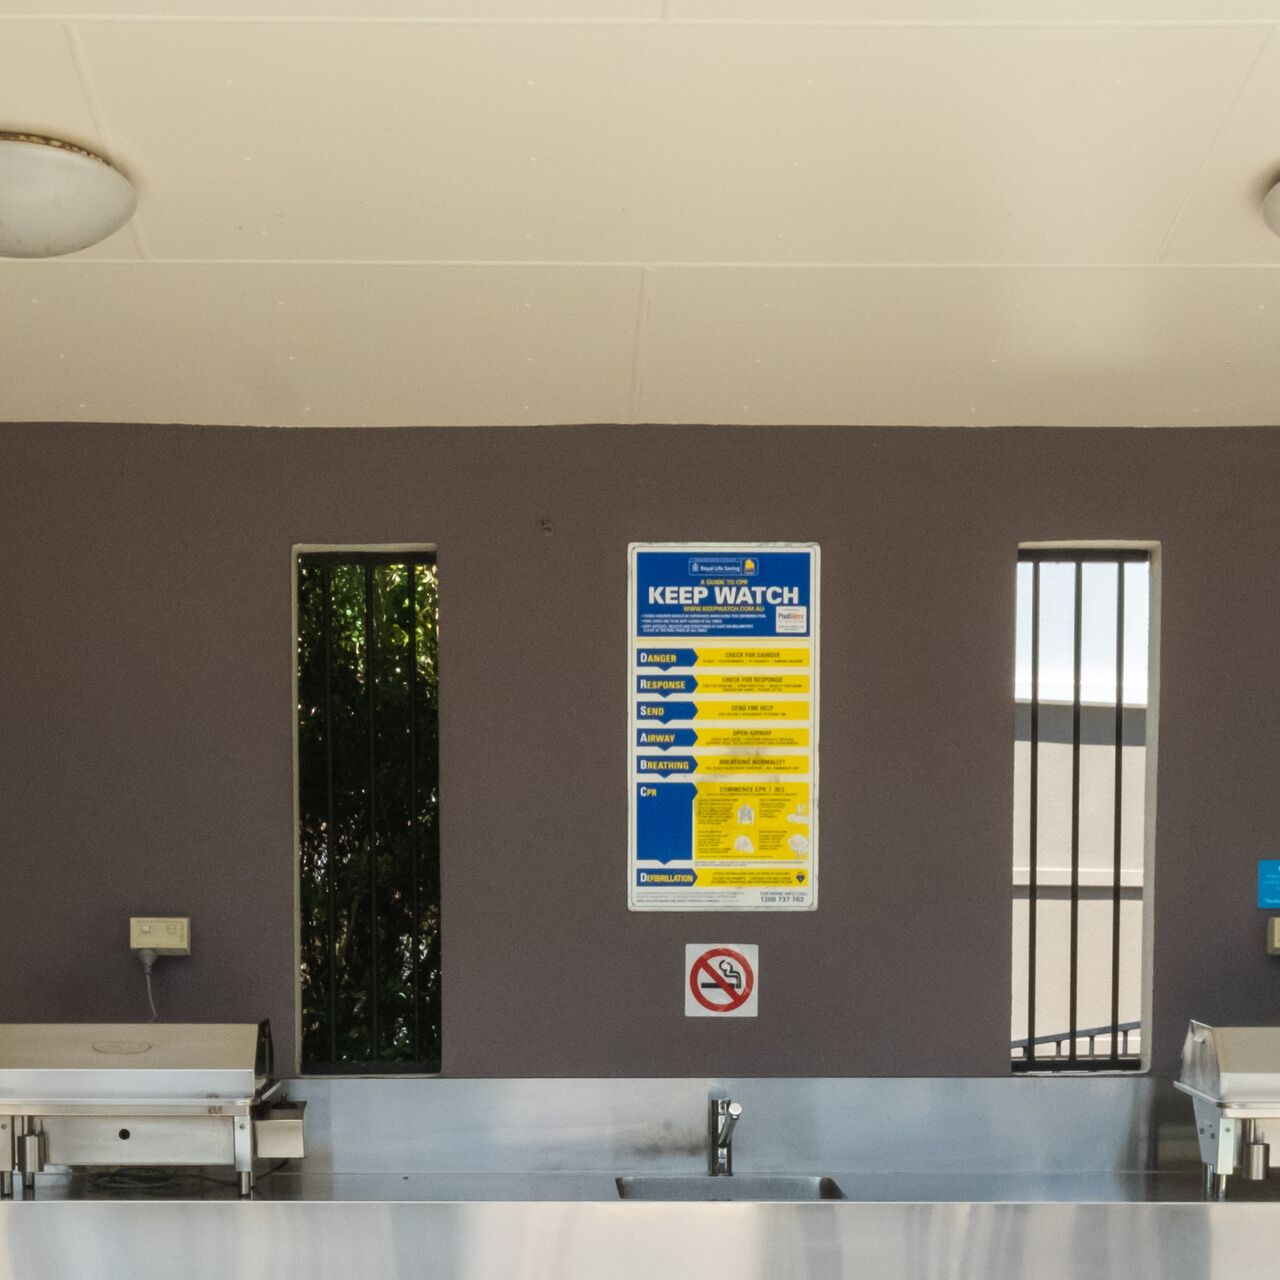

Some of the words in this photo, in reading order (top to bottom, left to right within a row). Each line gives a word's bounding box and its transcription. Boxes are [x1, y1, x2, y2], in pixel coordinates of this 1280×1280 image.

[648, 586, 709, 604] KEEP
[714, 586, 799, 604] WATCH
[640, 653, 677, 663] DANGER
[640, 679, 686, 689] RESPONSE
[640, 706, 664, 716] SEND
[640, 732, 676, 743] AIRWAY
[640, 760, 689, 770] BREATHING
[640, 787, 657, 797] CPR
